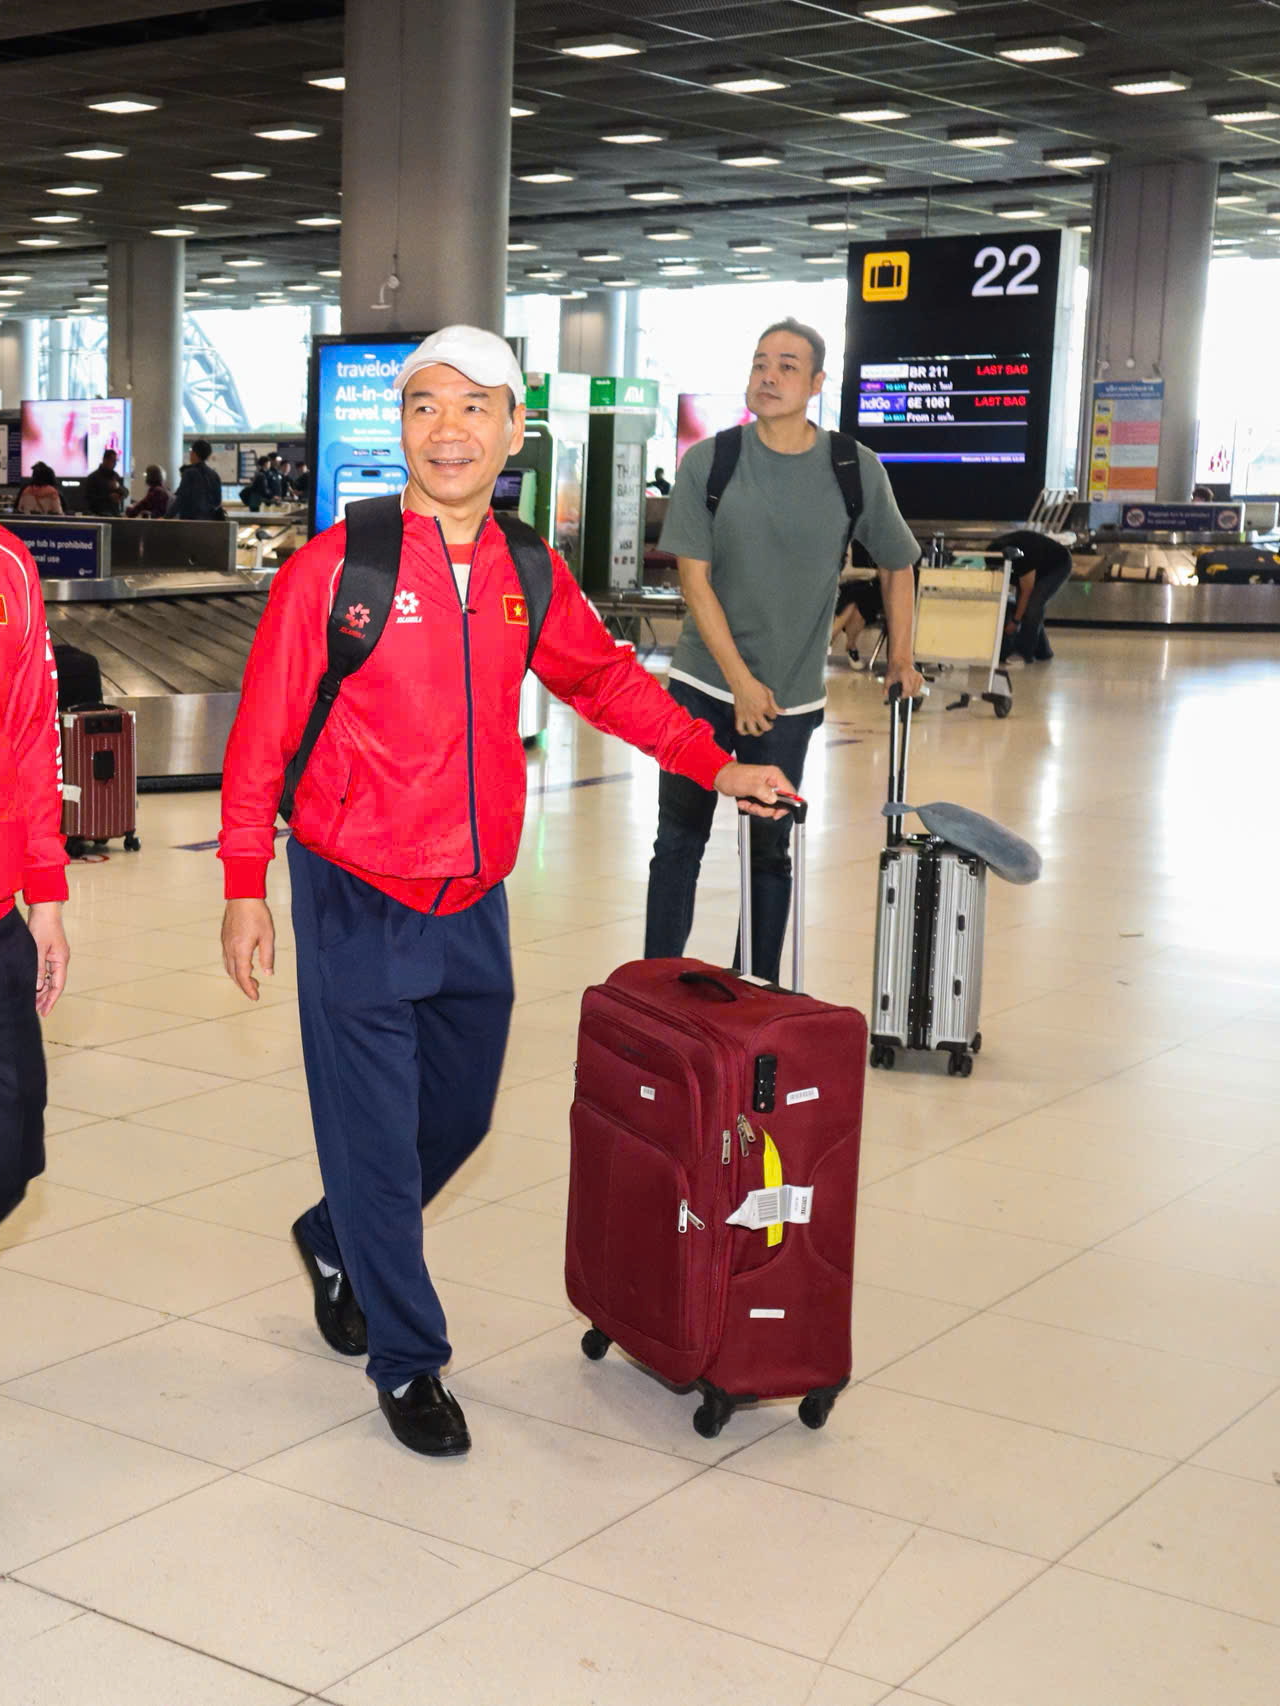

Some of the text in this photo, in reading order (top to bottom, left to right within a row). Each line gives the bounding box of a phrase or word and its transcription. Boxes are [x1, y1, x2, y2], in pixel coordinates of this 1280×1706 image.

[971, 244, 1041, 297] 22
[337, 360, 404, 377] travelok
[910, 366, 927, 378] BR
[928, 366, 948, 378] 211
[976, 364, 1028, 376] LAST BAG
[908, 381, 931, 391] From
[335, 385, 403, 402] All-in-on
[860, 398, 891, 410] IndiGo
[907, 397, 922, 409] 6E
[974, 396, 1026, 407] LAST BAG
[335, 404, 401, 424] travel ap
[906, 412, 930, 422] From
[57, 540, 93, 551] prohibited
